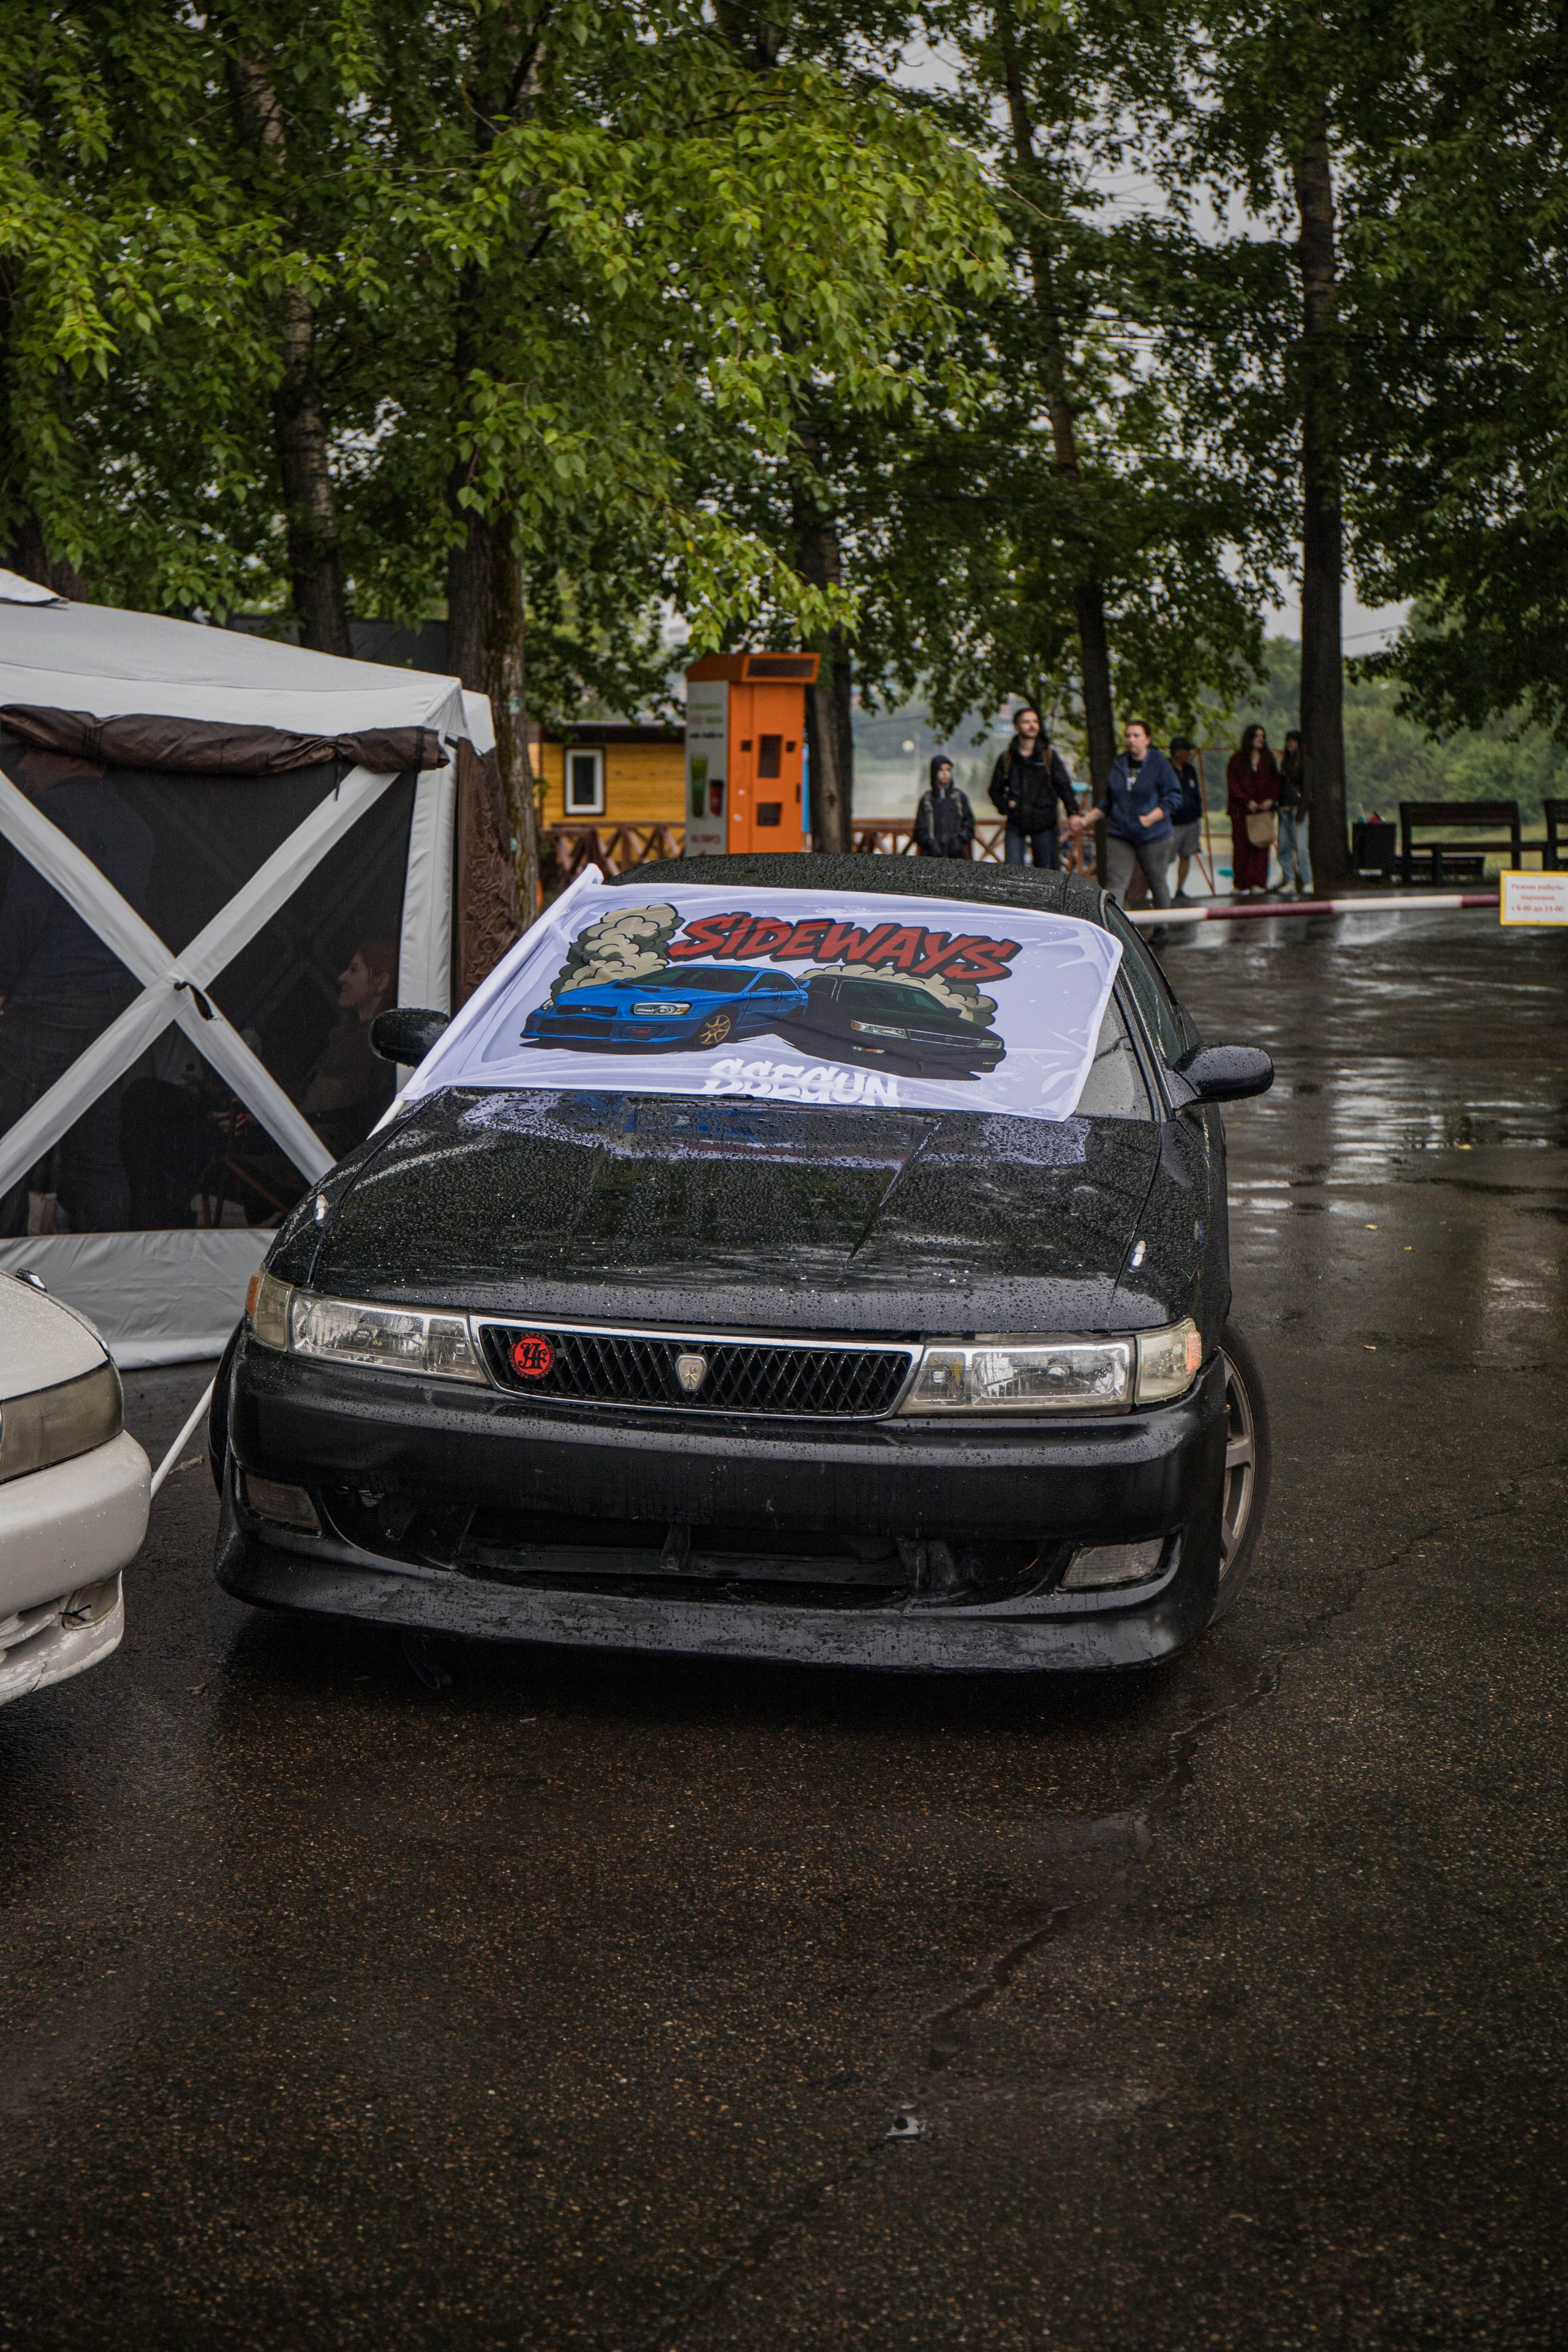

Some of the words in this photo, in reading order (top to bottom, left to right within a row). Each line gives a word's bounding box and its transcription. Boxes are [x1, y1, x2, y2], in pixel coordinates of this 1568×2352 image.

[667, 912, 1022, 983] SIDEWAYS
[702, 1058, 900, 1107] SSEGUN
[521, 1332, 546, 1341] JAPAN
[509, 1343, 529, 1378] FEDERATION
[535, 1345, 555, 1379] AUTOMOBILE
